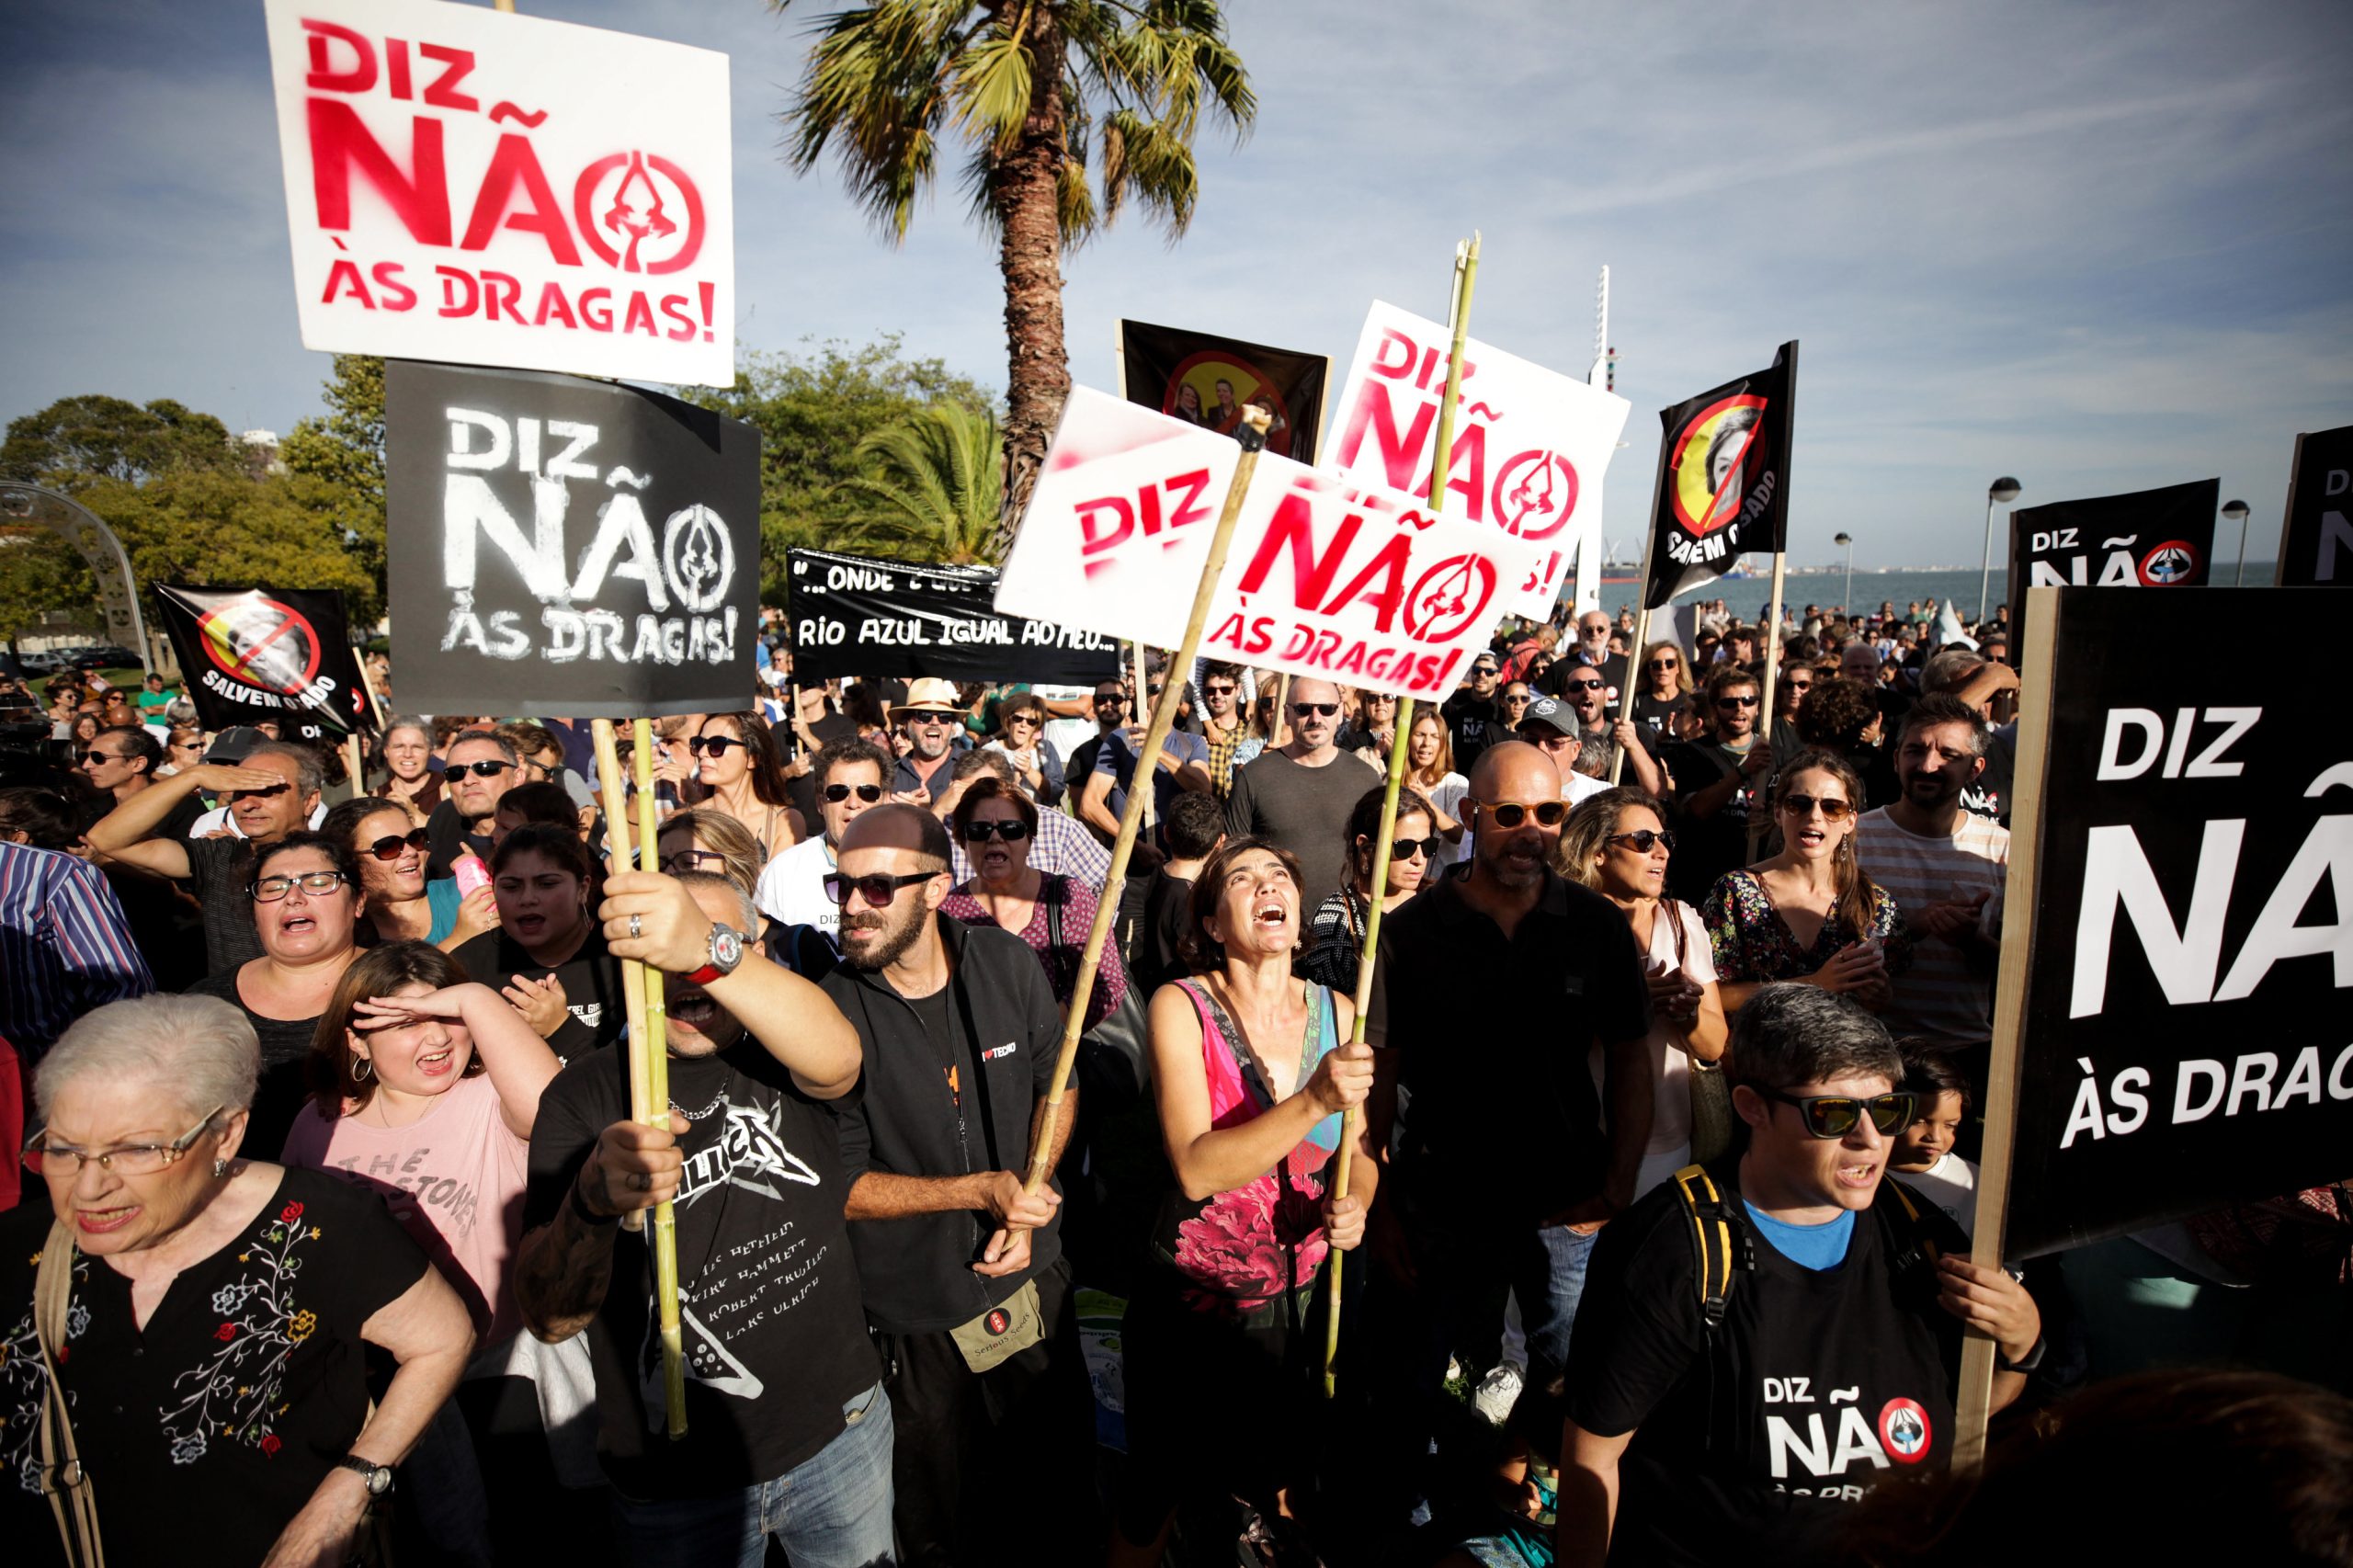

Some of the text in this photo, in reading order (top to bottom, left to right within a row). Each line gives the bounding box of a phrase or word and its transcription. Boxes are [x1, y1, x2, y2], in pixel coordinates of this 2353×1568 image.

[301, 17, 479, 113] DIZ
[306, 97, 706, 275] NÃO
[322, 237, 715, 344] ÀS DRAGAS!
[446, 406, 599, 479] DIZ
[1335, 377, 1579, 541] NÃO
[1074, 468, 1213, 555] DIZ
[1739, 470, 1776, 528] SADO
[444, 465, 735, 613] NÃO
[1237, 493, 1496, 643] NÃO
[2031, 528, 2079, 551] DIZ
[541, 606, 738, 665] DRAGAS!
[858, 618, 930, 645] AZUL
[938, 619, 1013, 645] IGUAL
[1021, 619, 1055, 646] AO
[1207, 596, 1463, 691] ÀS DRAGAS!
[202, 670, 282, 708] SALVEM
[297, 676, 336, 710] ADO
[2096, 707, 2262, 780] DIZ
[820, 915, 840, 925] DIZ
[2060, 1056, 2150, 1150] ÀS
[338, 1148, 430, 1178] THE
[975, 1312, 1029, 1357] Serious Seeds
[1763, 1377, 1815, 1403] DIZ
[1766, 1386, 1932, 1478] NÃO
